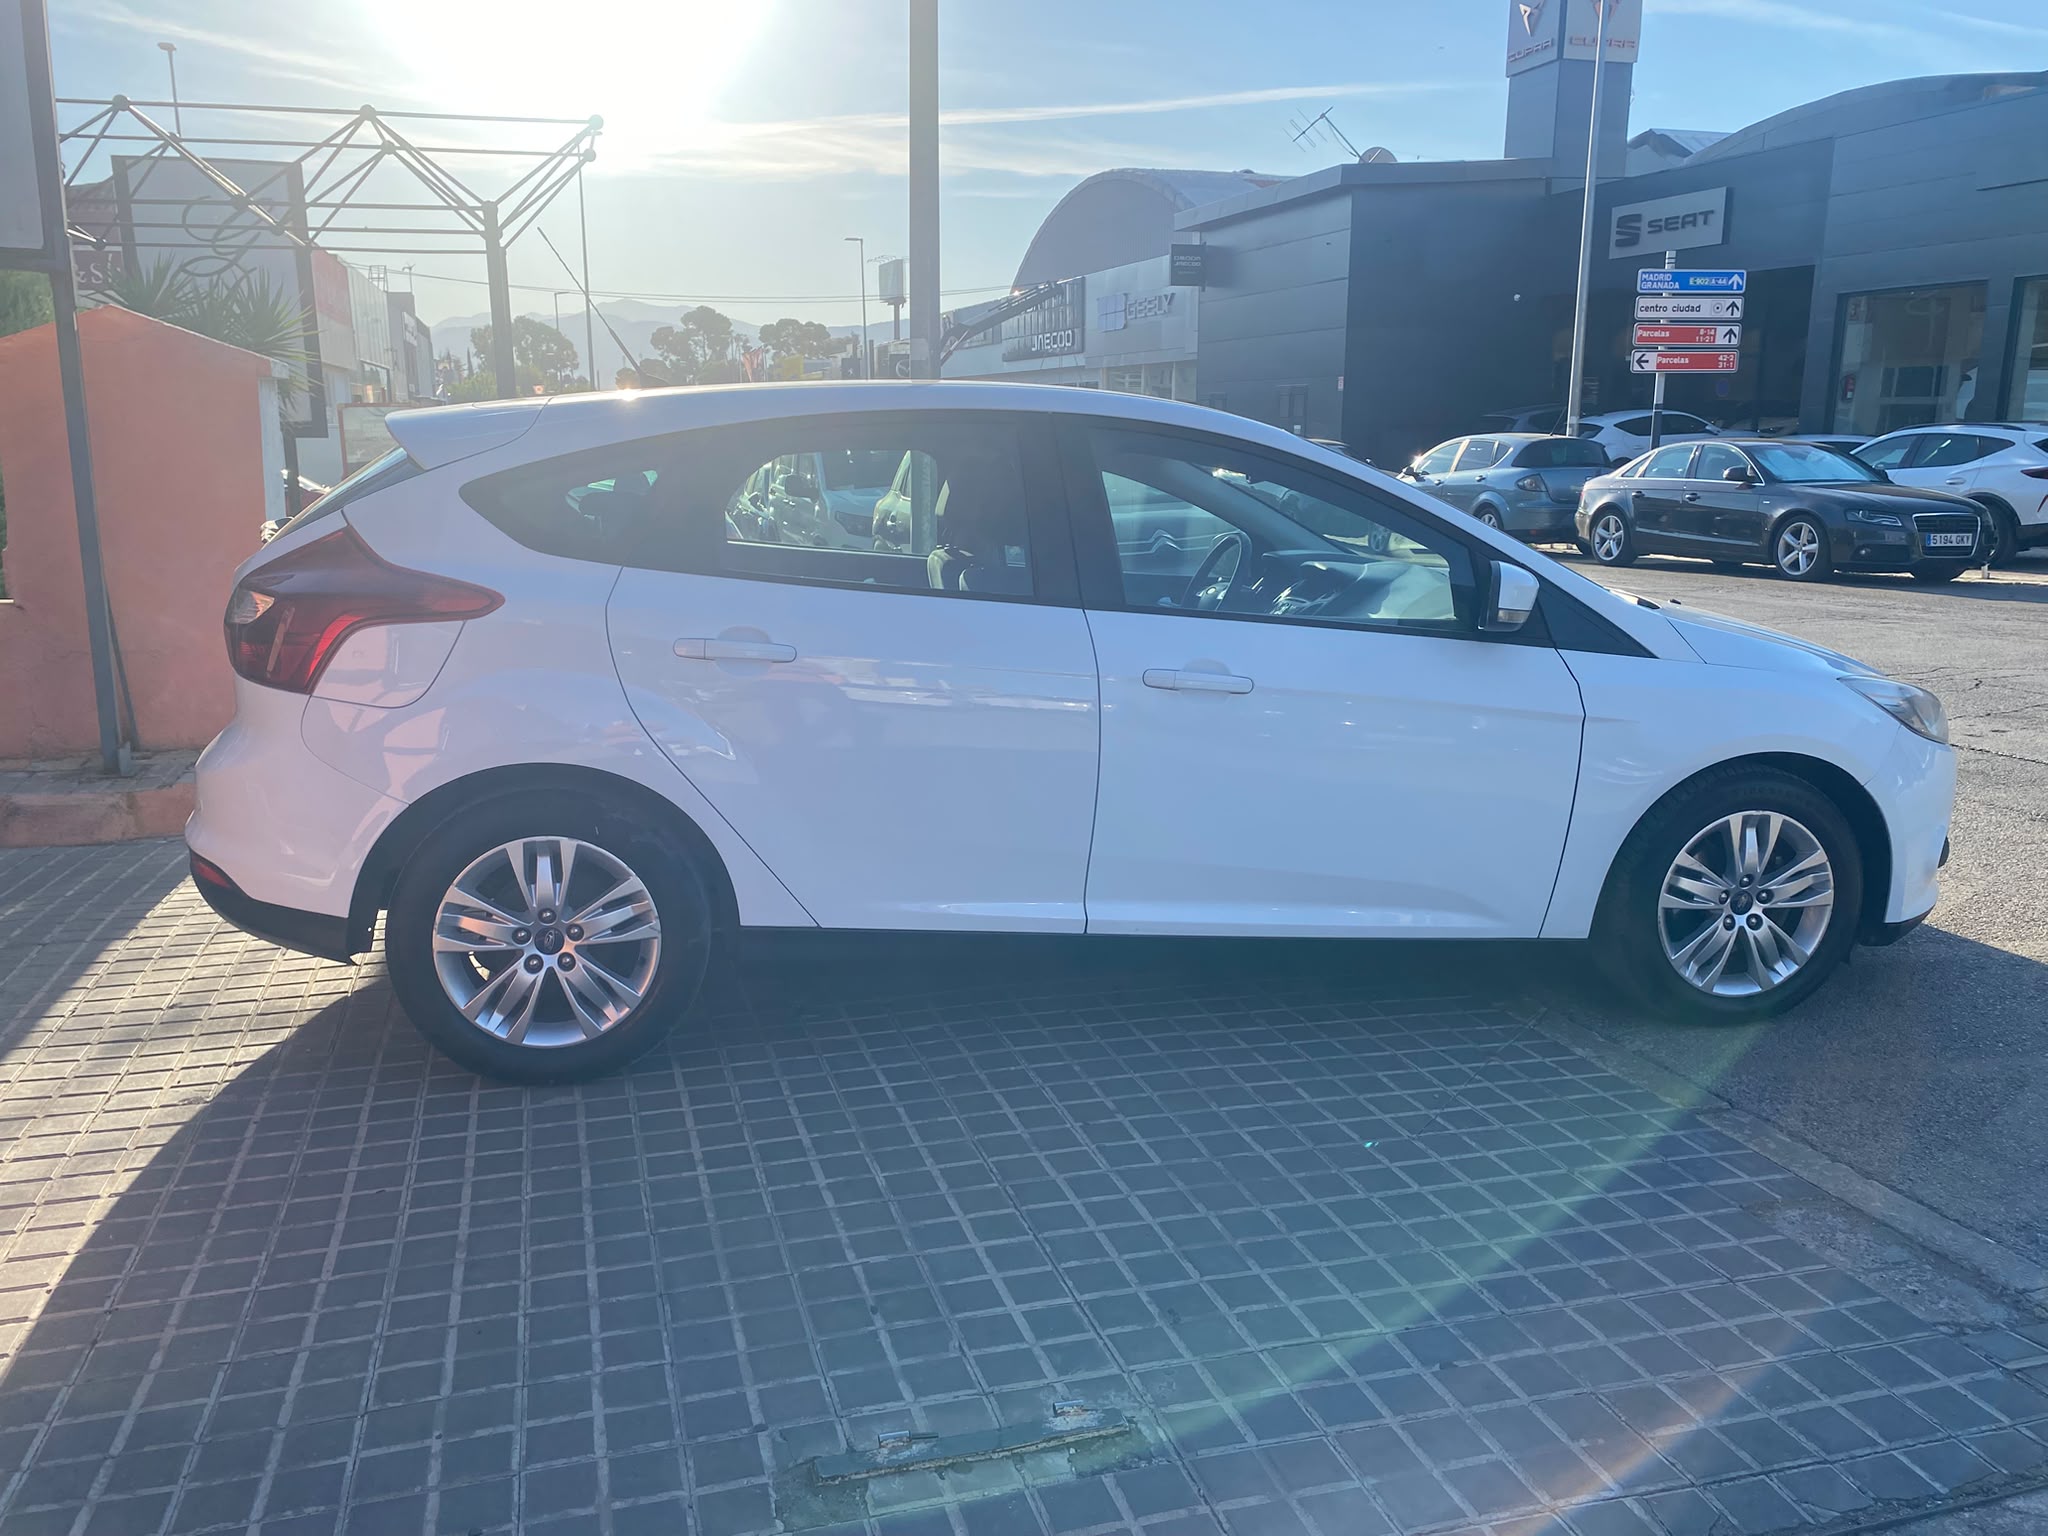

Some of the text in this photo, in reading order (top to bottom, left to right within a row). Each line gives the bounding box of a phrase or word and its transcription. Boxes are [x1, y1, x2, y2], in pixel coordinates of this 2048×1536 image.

[1569, 36, 1636, 49] CURA
[1508, 38, 1554, 62] CUPRA
[1647, 210, 1714, 234] SEAT
[1641, 273, 1672, 281] MADRID
[1641, 281, 1680, 289] GRANADA
[1125, 292, 1175, 320] GEELY
[1639, 302, 1701, 312] centro ciudad
[1637, 329, 1669, 337] Parcelas
[1032, 329, 1073, 351] JAECOO
[1657, 356, 1689, 364] Parcelas
[1932, 534, 1971, 545] 5194 GKY
